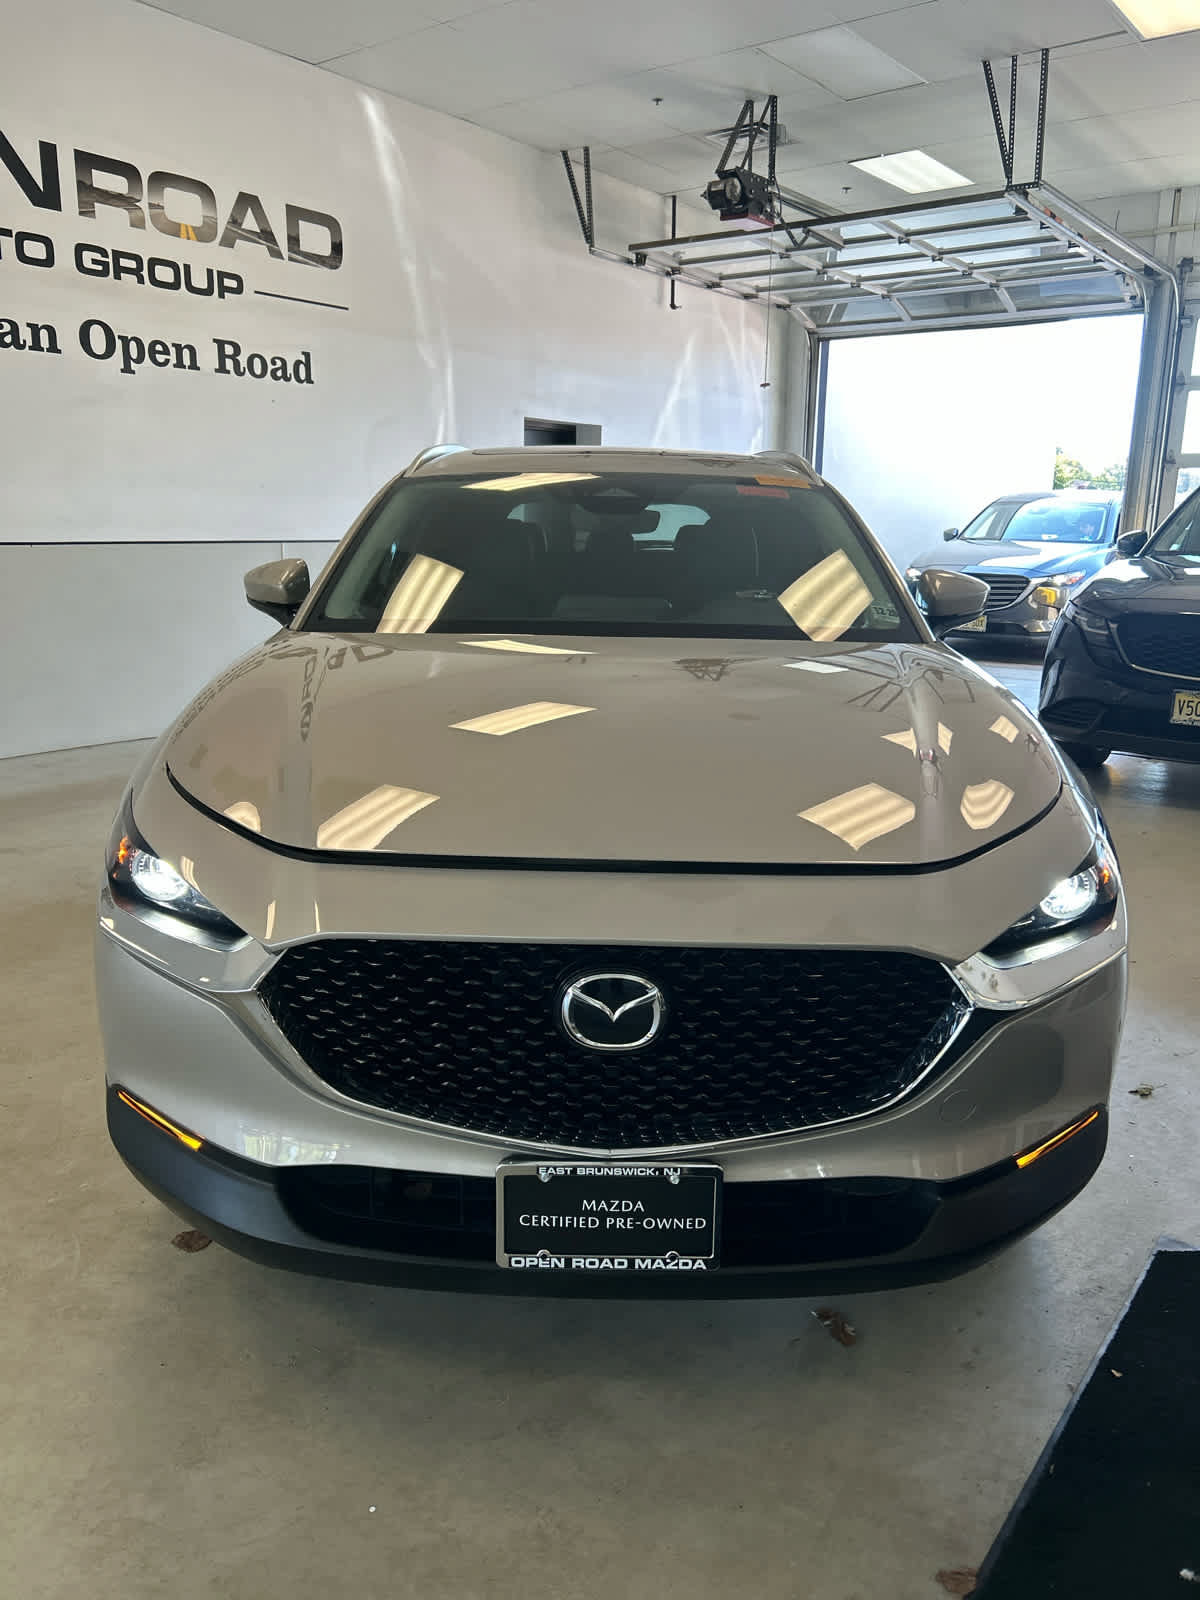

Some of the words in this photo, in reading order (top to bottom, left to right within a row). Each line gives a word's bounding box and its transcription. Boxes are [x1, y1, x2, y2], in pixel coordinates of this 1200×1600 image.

[74, 242, 244, 299] GROUP
[79, 319, 200, 375] Open
[213, 338, 314, 385] Road
[538, 1167, 573, 1175] EAST
[663, 1167, 681, 1176] NJ
[582, 1199, 645, 1212] MAZDA
[519, 1214, 600, 1228] CERTIFIED
[606, 1217, 707, 1230] PRE-OWNED
[510, 1257, 565, 1269] OPEN
[571, 1258, 628, 1269] ROAD
[634, 1258, 707, 1270] MAZDA
